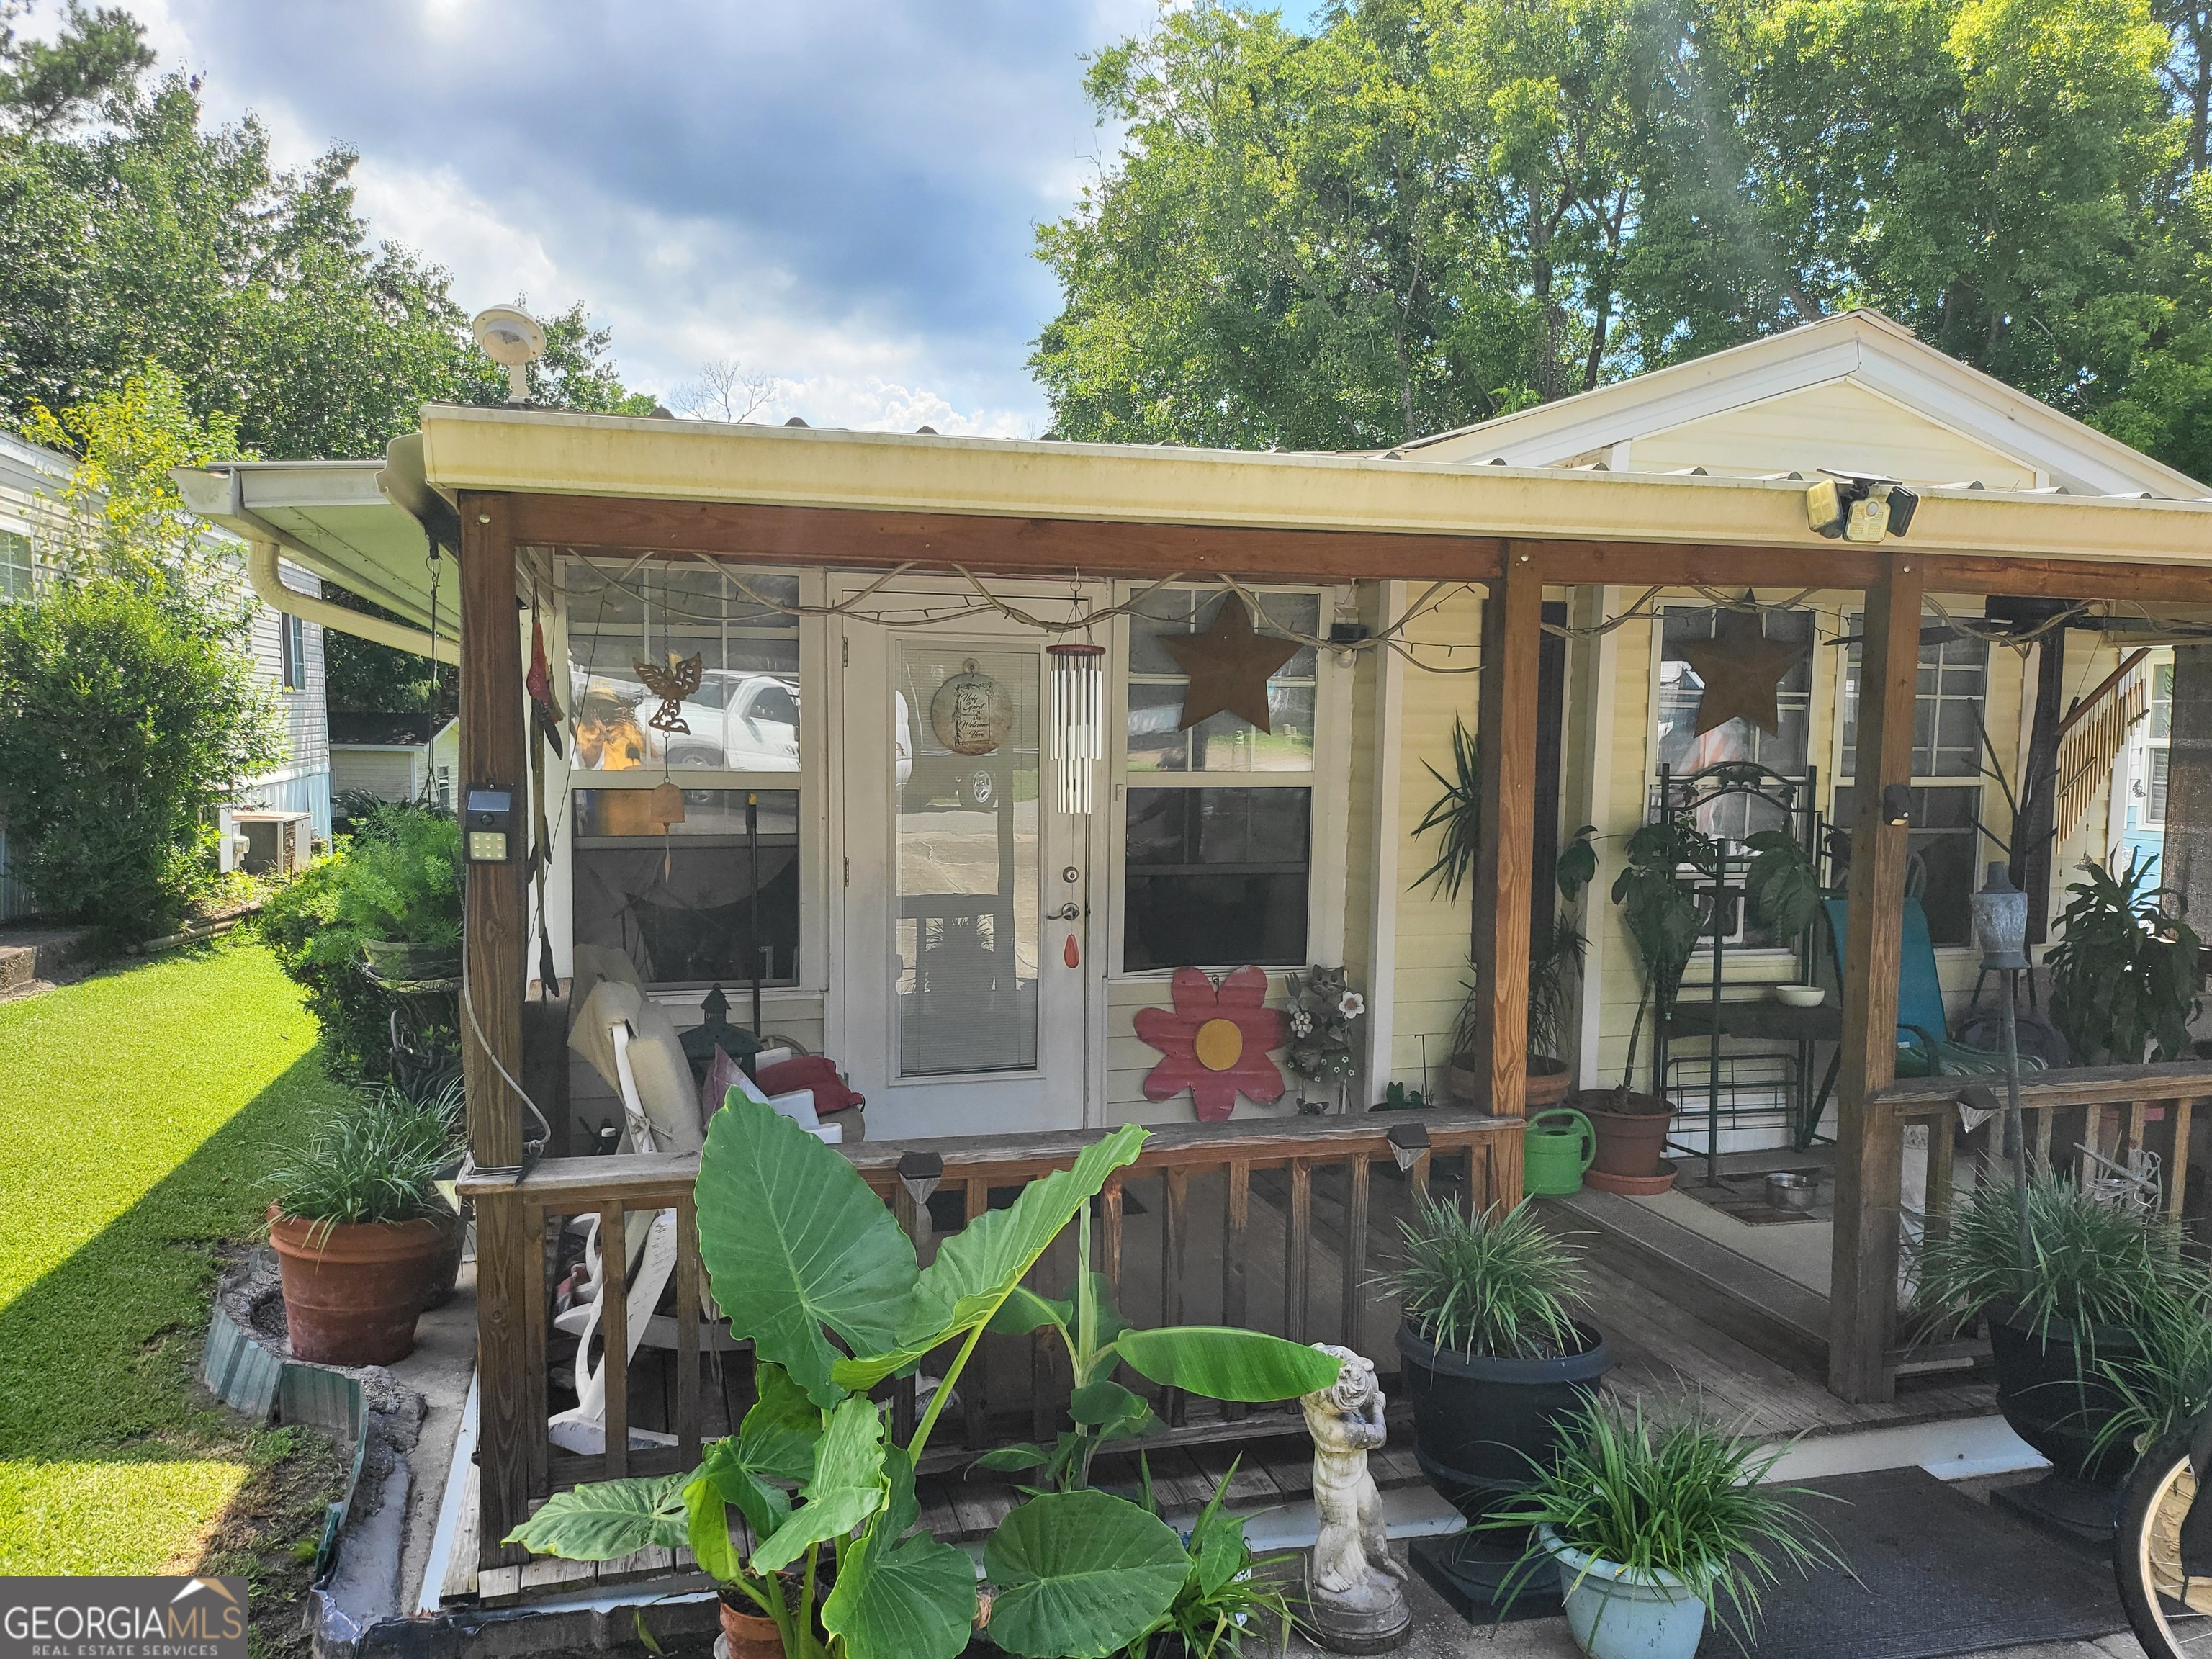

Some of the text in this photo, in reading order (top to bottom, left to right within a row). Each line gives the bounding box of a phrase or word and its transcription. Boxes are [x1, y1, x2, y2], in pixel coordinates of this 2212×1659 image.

[960, 693, 979, 703] Holy
[963, 702, 986, 712] Spirit
[959, 720, 989, 729] Welcome
[968, 730, 986, 739] Here
